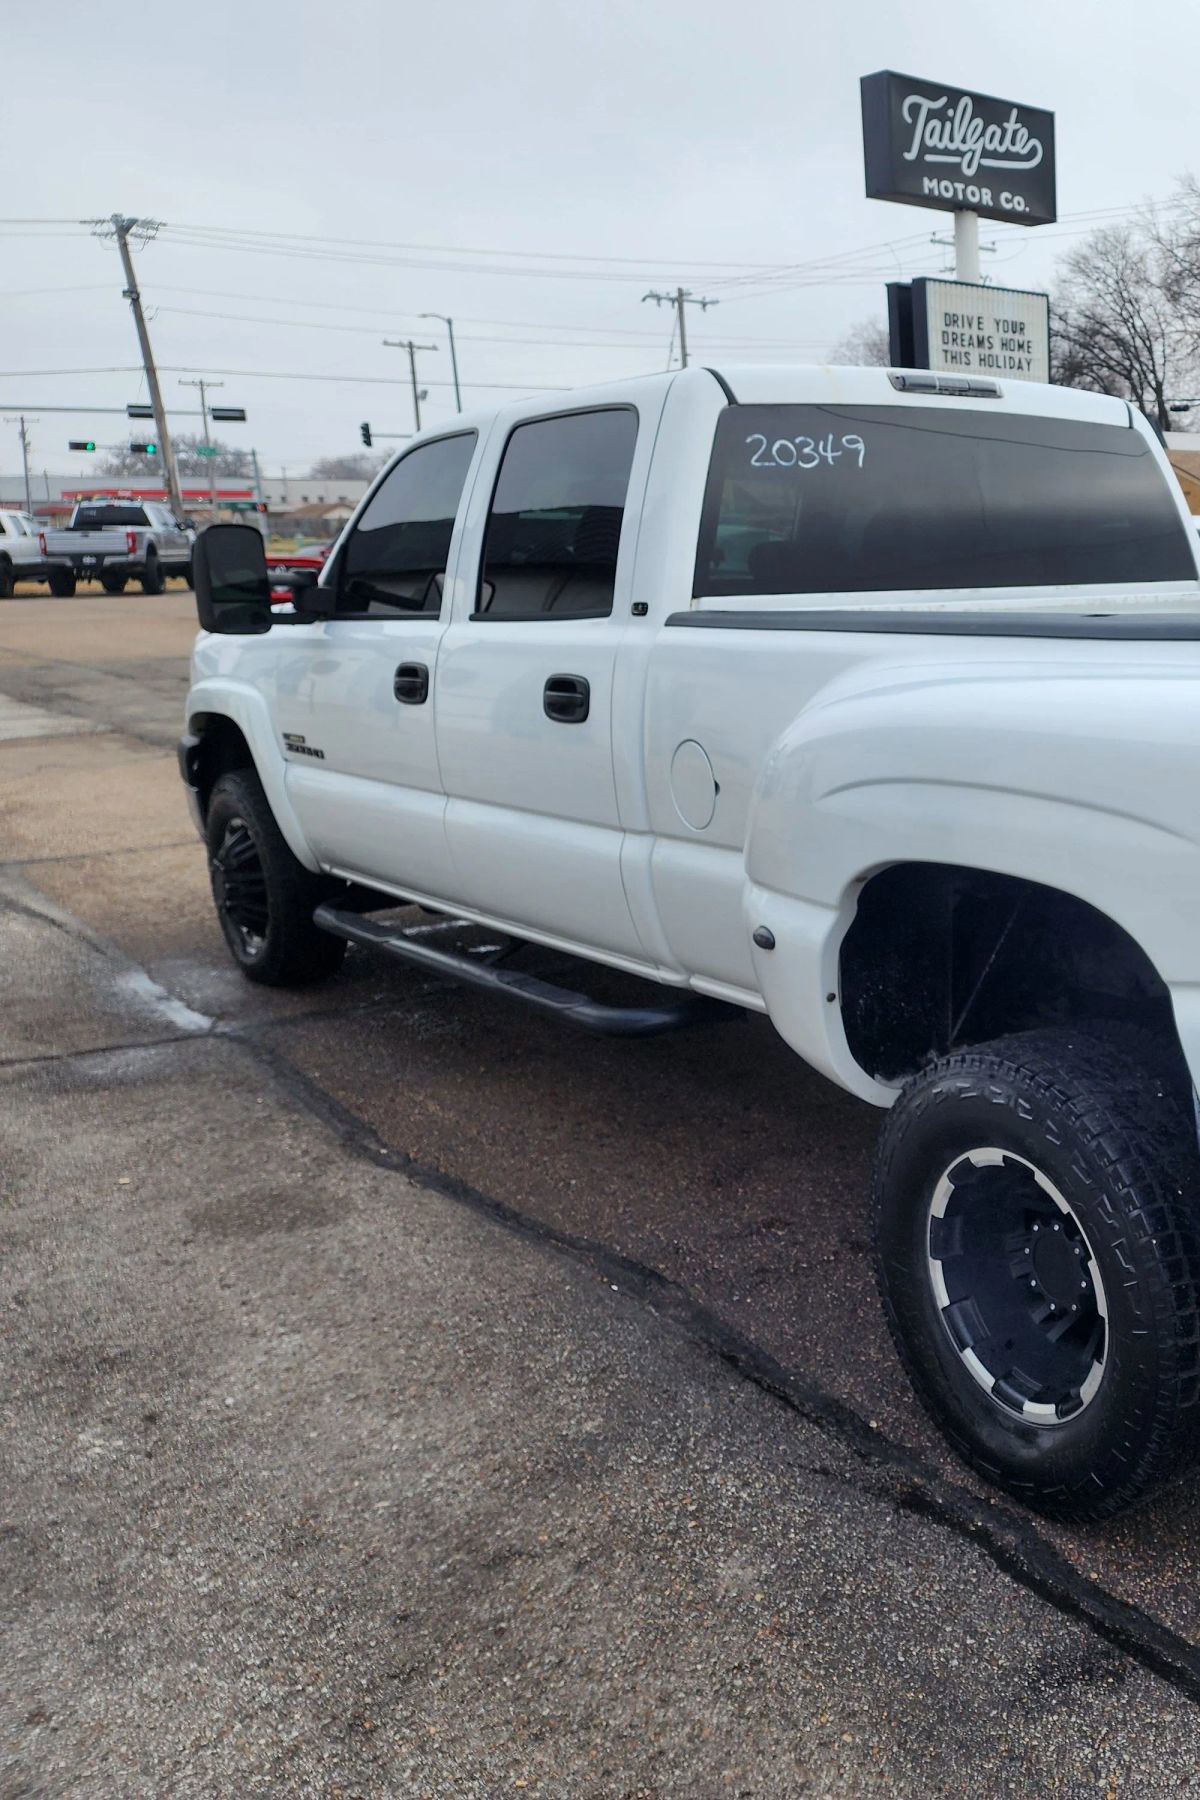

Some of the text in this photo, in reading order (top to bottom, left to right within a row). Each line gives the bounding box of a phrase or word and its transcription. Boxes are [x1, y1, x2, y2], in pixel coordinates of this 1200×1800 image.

[902, 94, 1043, 177] Tailgate
[922, 176, 1030, 212] MOTOR CO.
[944, 312, 1026, 336] DRIVE YOUR
[941, 330, 1033, 354] DREAMS HOME
[942, 349, 1033, 372] THIS HOLIDAY
[745, 432, 866, 468] 20349
